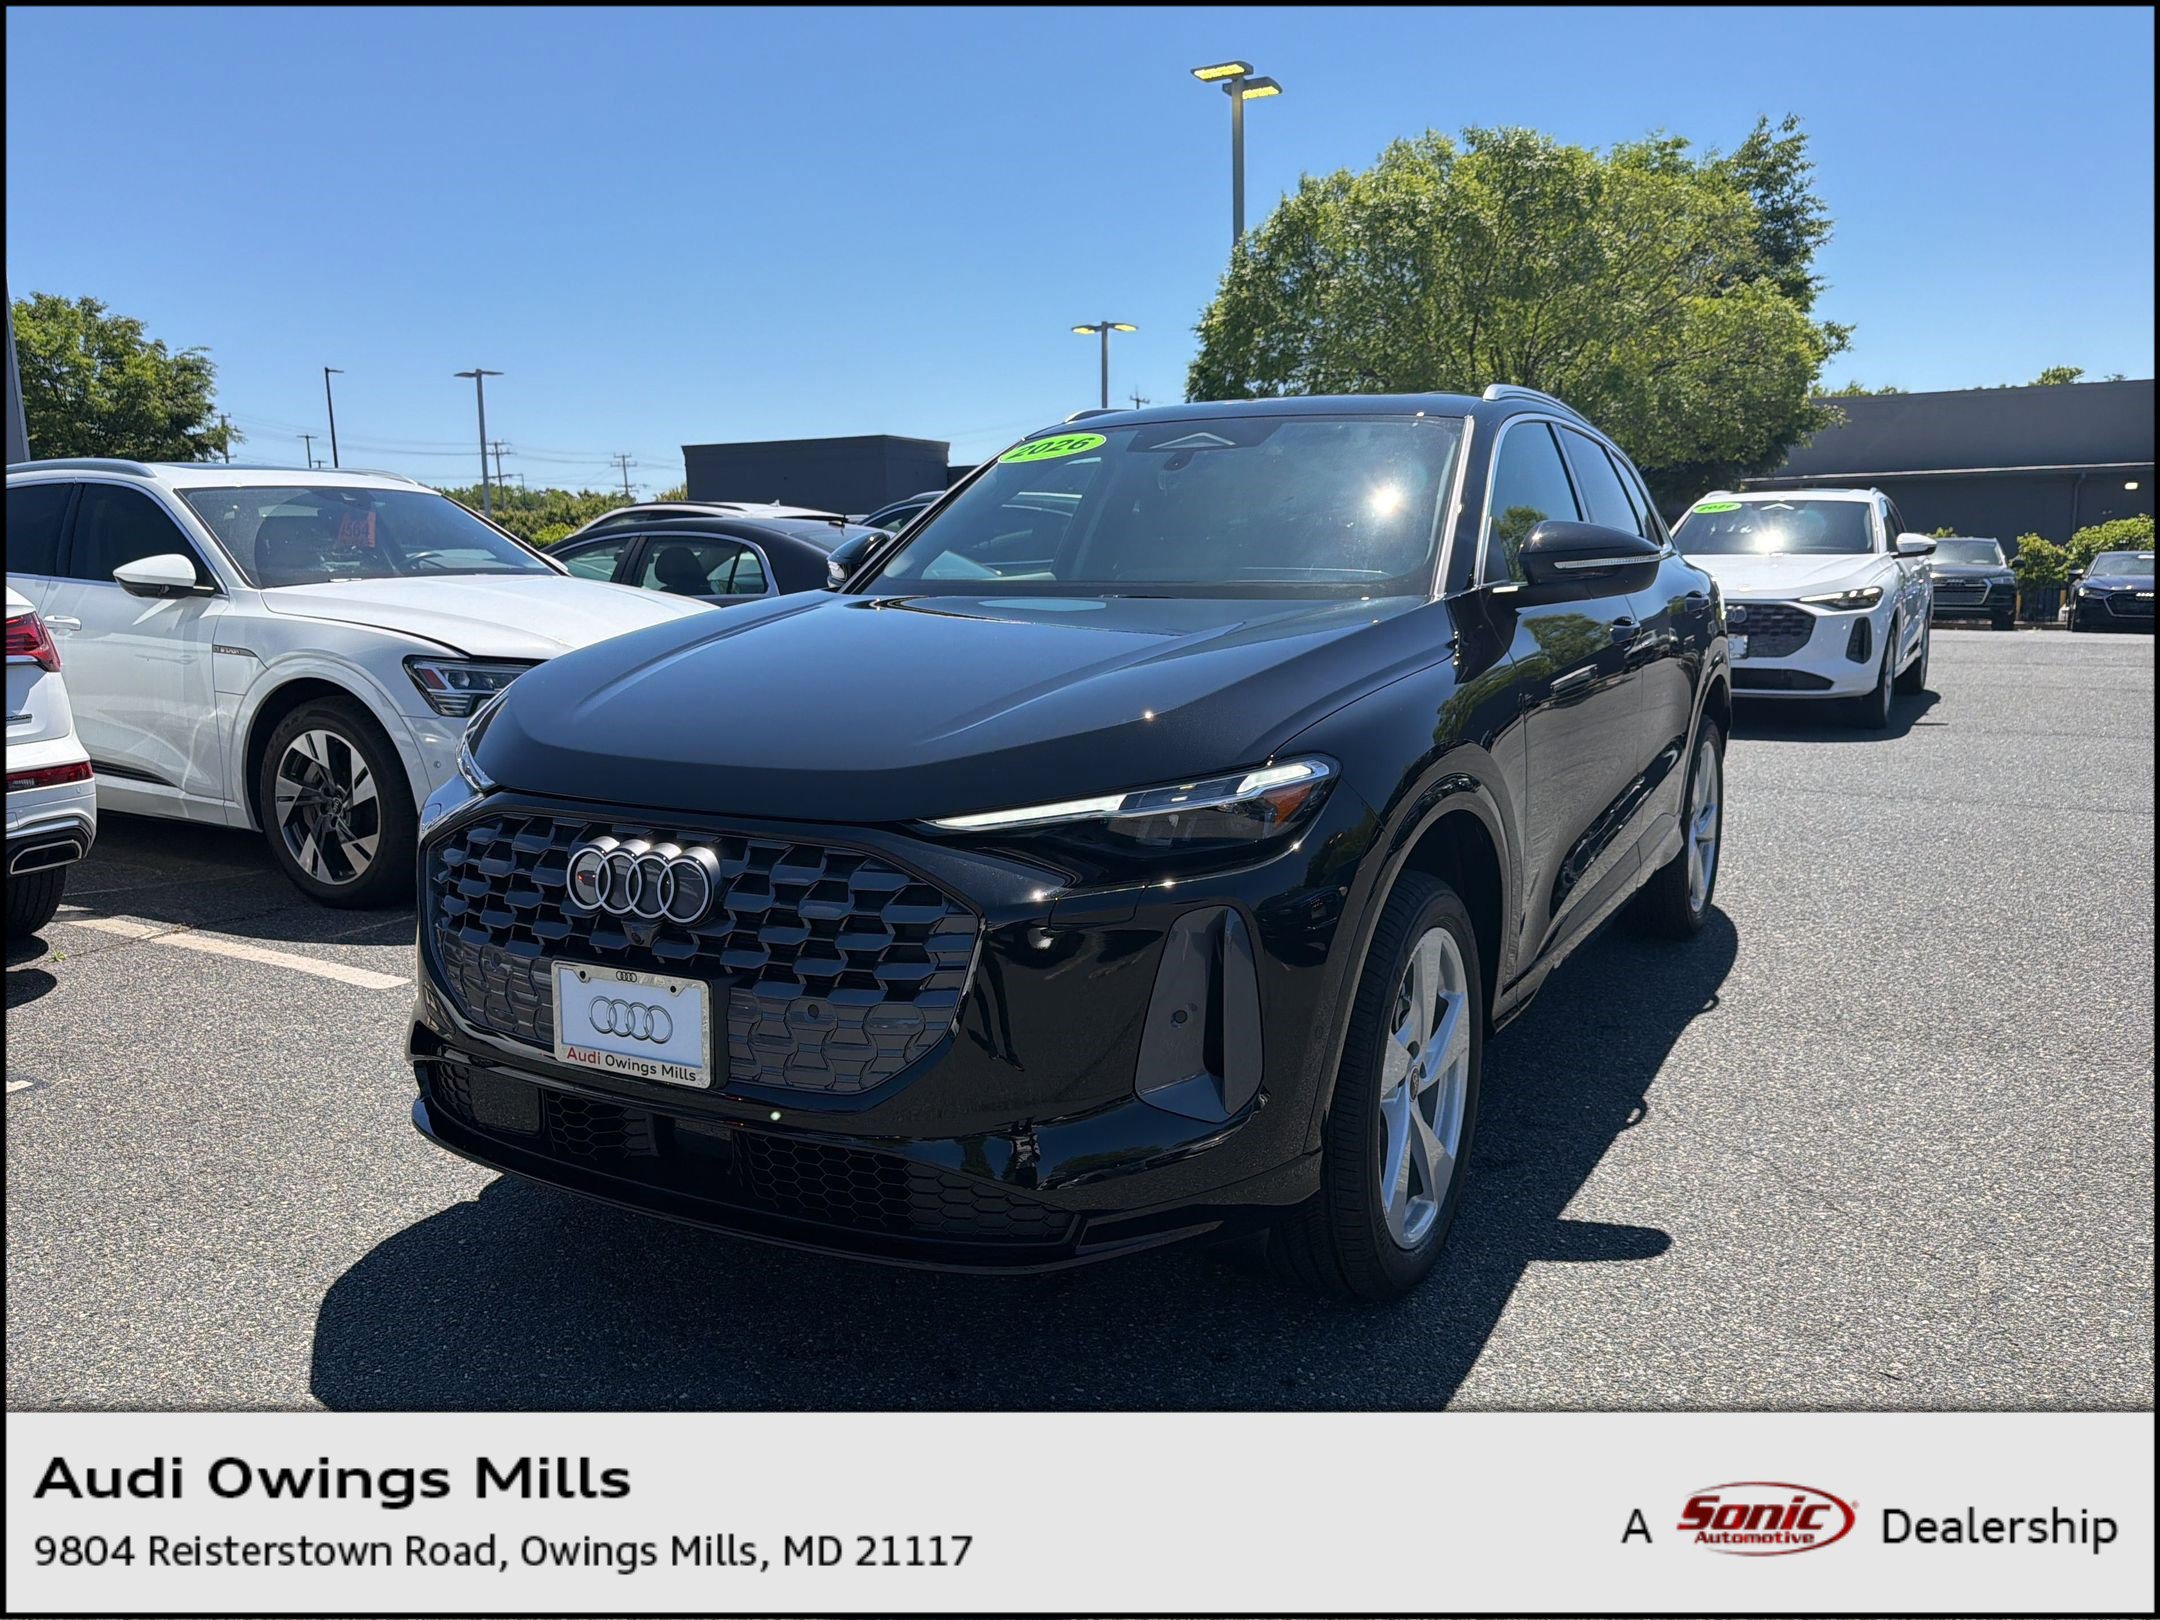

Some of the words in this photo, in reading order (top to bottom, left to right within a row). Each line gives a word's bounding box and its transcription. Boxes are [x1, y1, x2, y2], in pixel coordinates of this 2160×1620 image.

[1005, 437, 1096, 460] 2026
[566, 1047, 601, 1064] Audi
[605, 1054, 657, 1076] Owings
[661, 1064, 697, 1081] Mills
